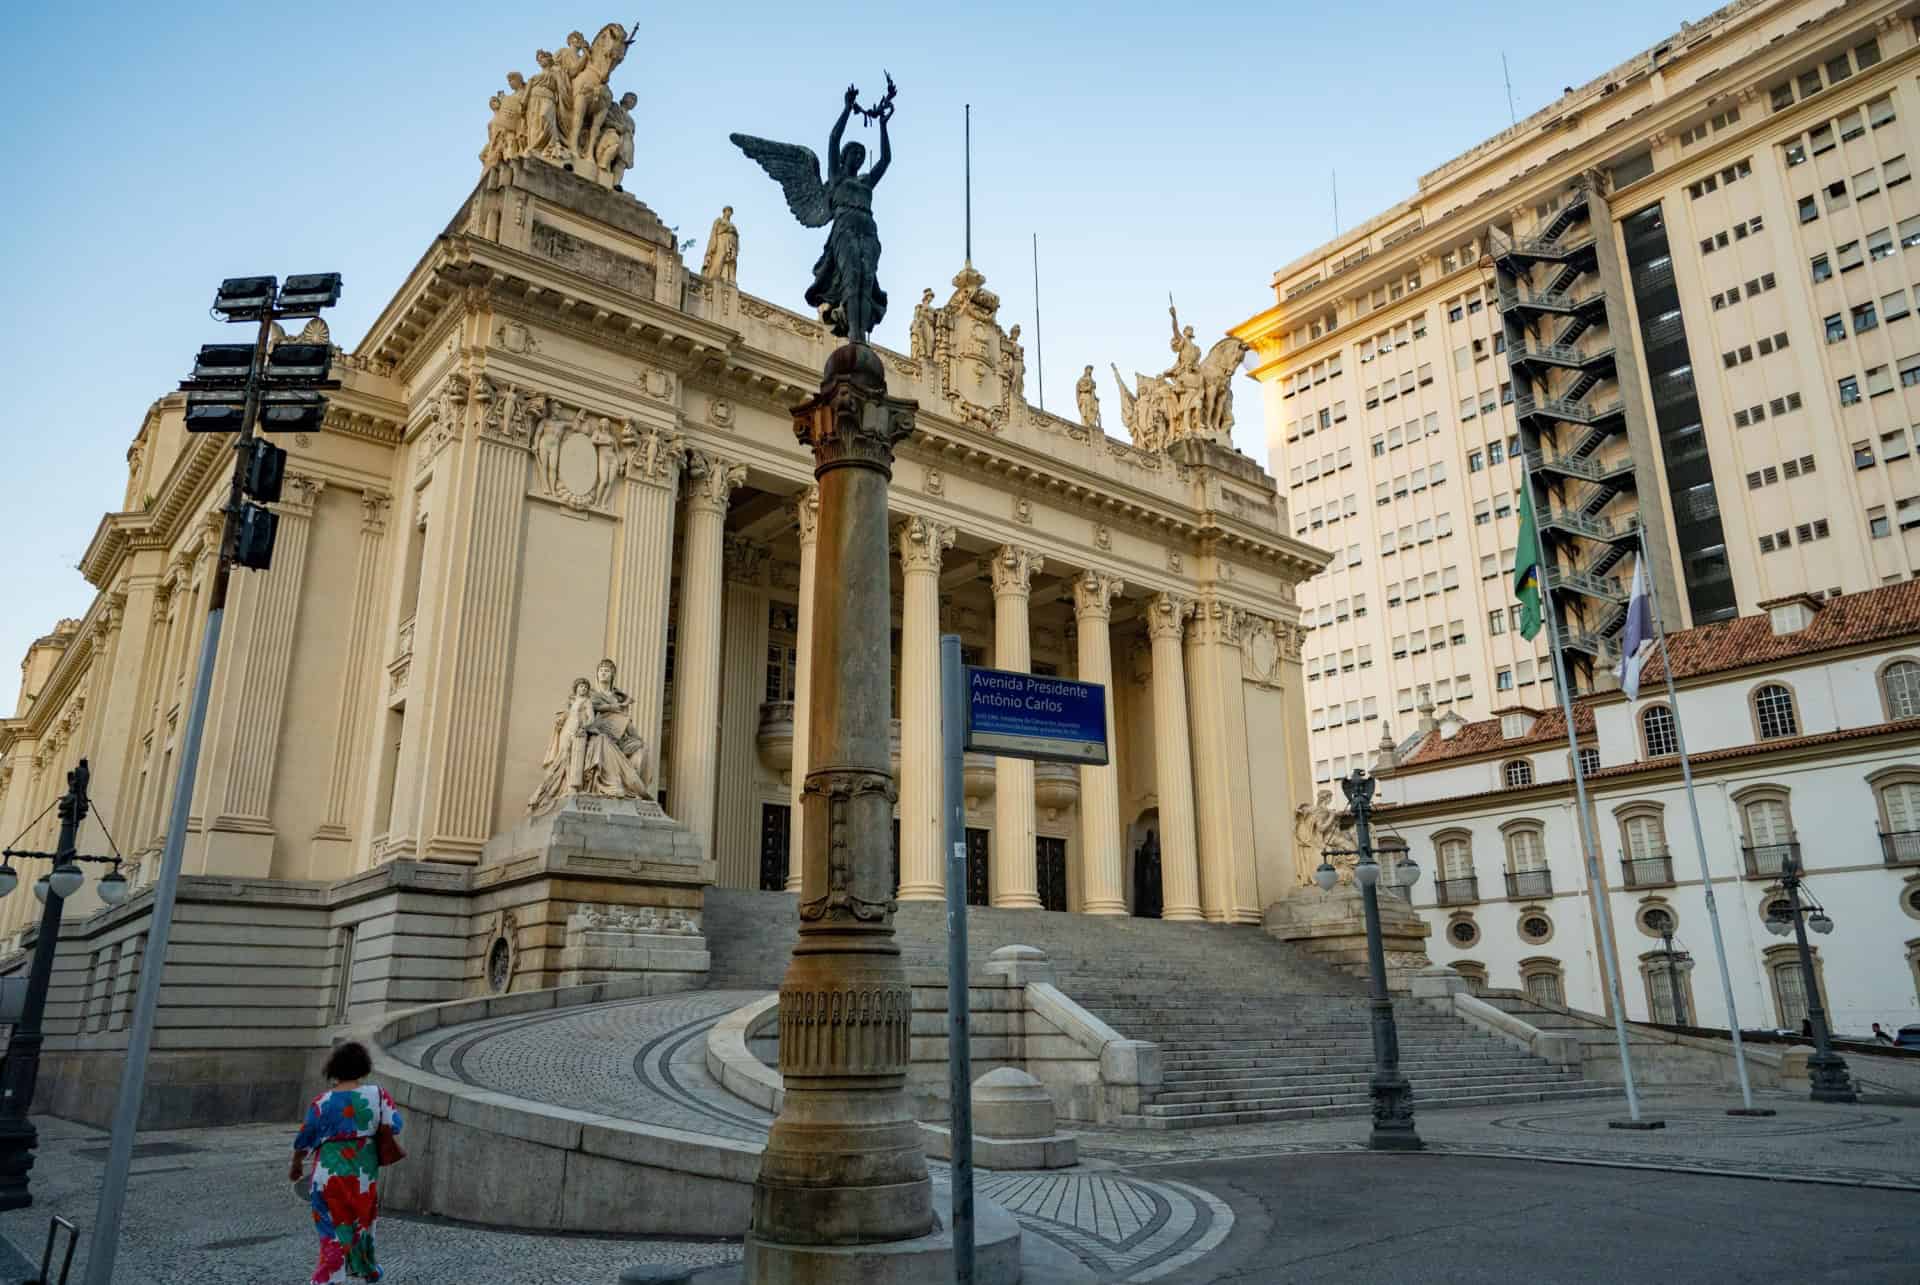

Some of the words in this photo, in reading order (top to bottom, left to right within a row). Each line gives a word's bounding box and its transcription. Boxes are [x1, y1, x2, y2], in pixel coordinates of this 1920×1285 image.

[973, 673, 1023, 691] Avenida
[1027, 679, 1088, 698] Presidente
[1025, 696, 1063, 713] Carlos
